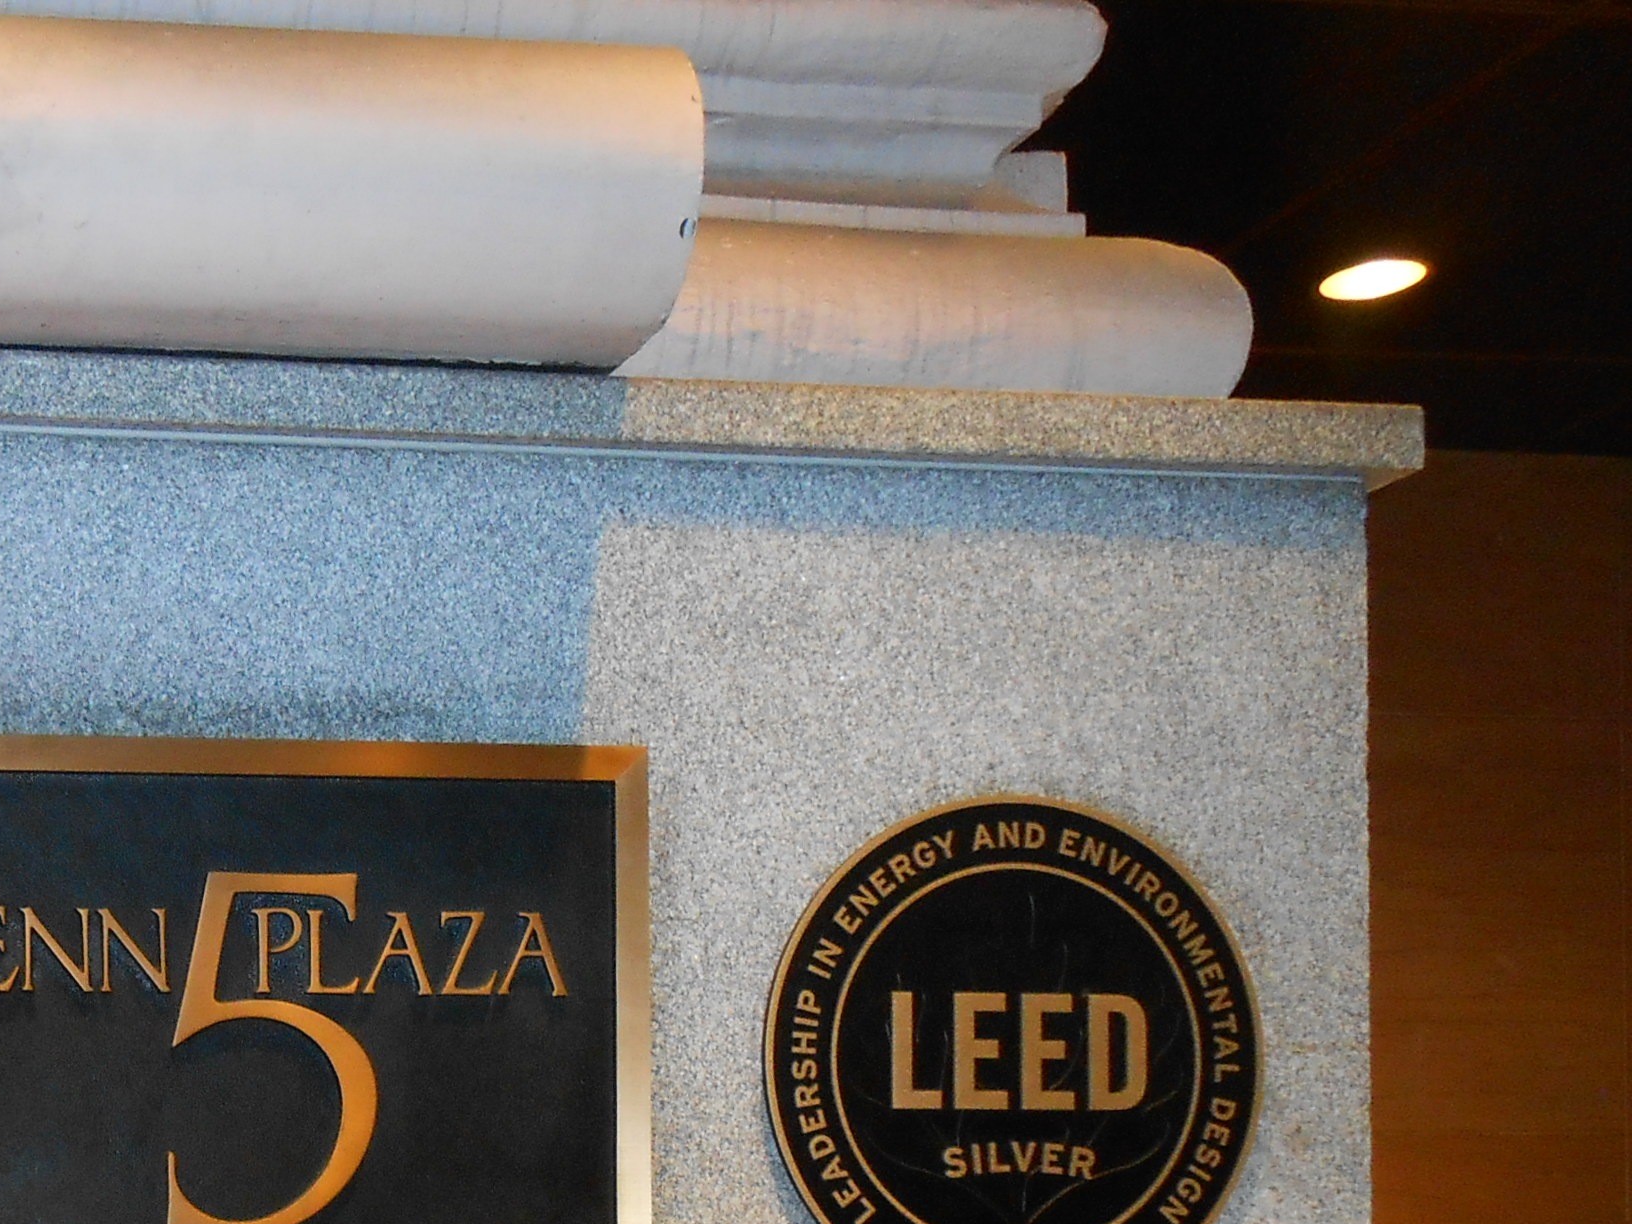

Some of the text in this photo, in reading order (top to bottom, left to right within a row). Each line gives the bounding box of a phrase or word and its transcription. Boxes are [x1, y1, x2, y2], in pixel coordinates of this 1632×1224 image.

[251, 909, 567, 997] PLAZA
[808, 944, 844, 979] IN
[835, 829, 959, 934] ENERGY
[972, 821, 1046, 854] AND
[1059, 829, 1241, 1083] ENVIRONMENTAL
[891, 990, 1149, 1112] LEED
[943, 1140, 1099, 1181] SILVER
